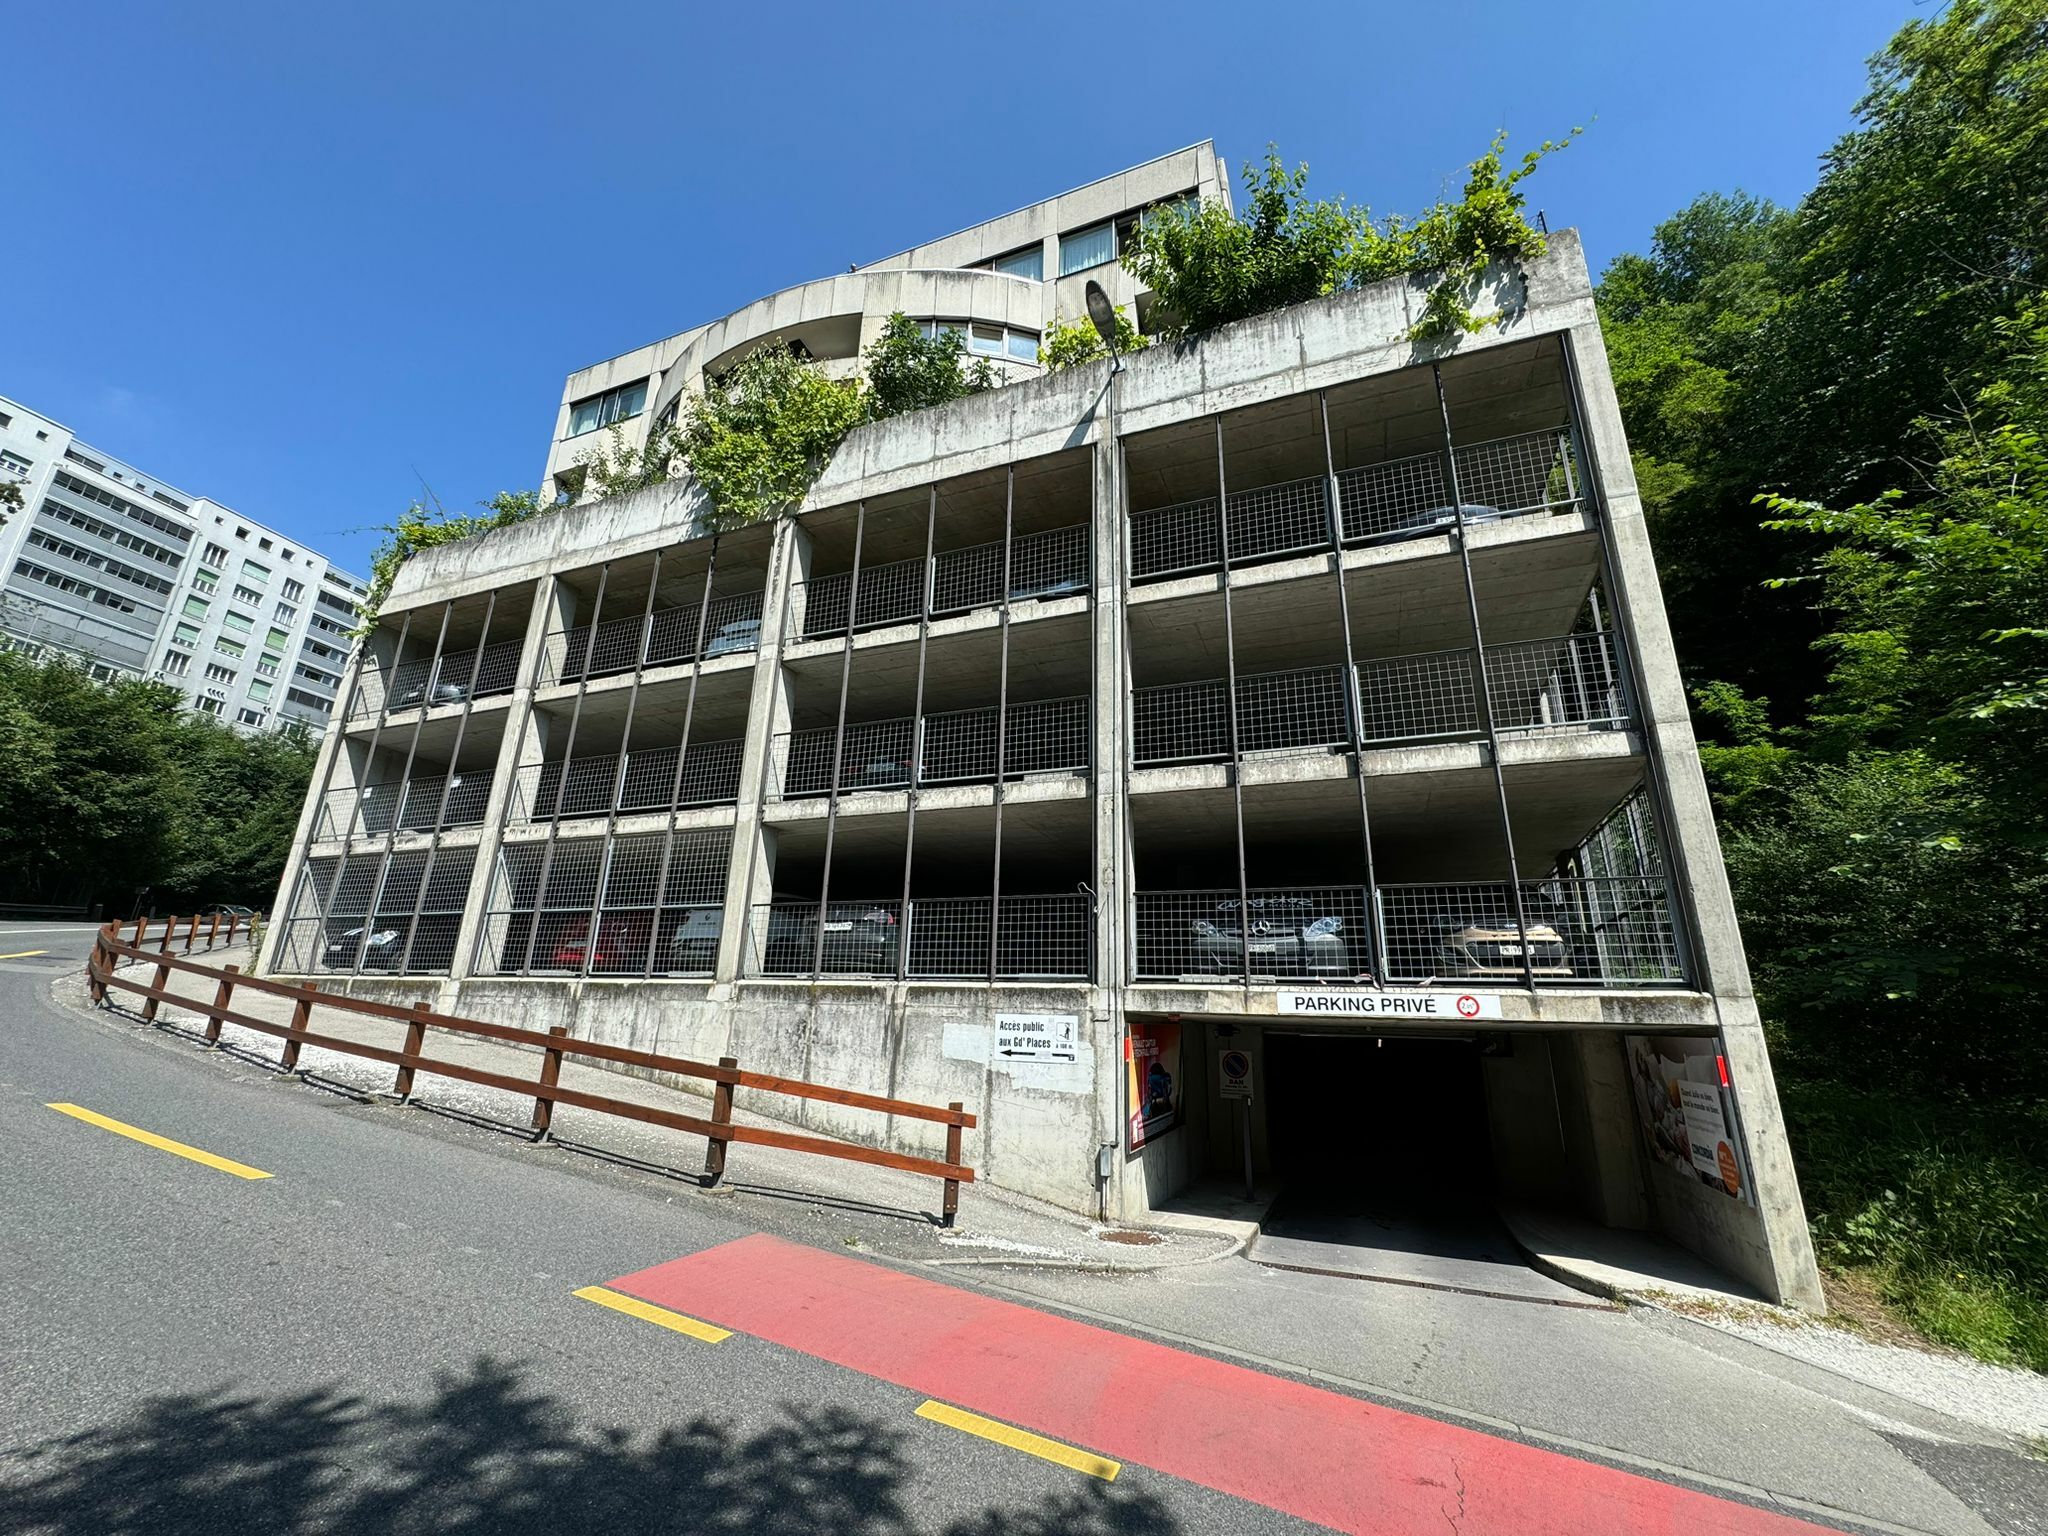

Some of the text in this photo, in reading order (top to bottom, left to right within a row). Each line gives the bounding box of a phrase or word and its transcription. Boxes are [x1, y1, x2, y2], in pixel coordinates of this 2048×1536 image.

[1295, 994, 1437, 1013] PARKING PRIVÉ
[1000, 1020, 1044, 1032] Accès public
[999, 1038, 1011, 1047] aux
[1027, 1038, 1051, 1048] Places
